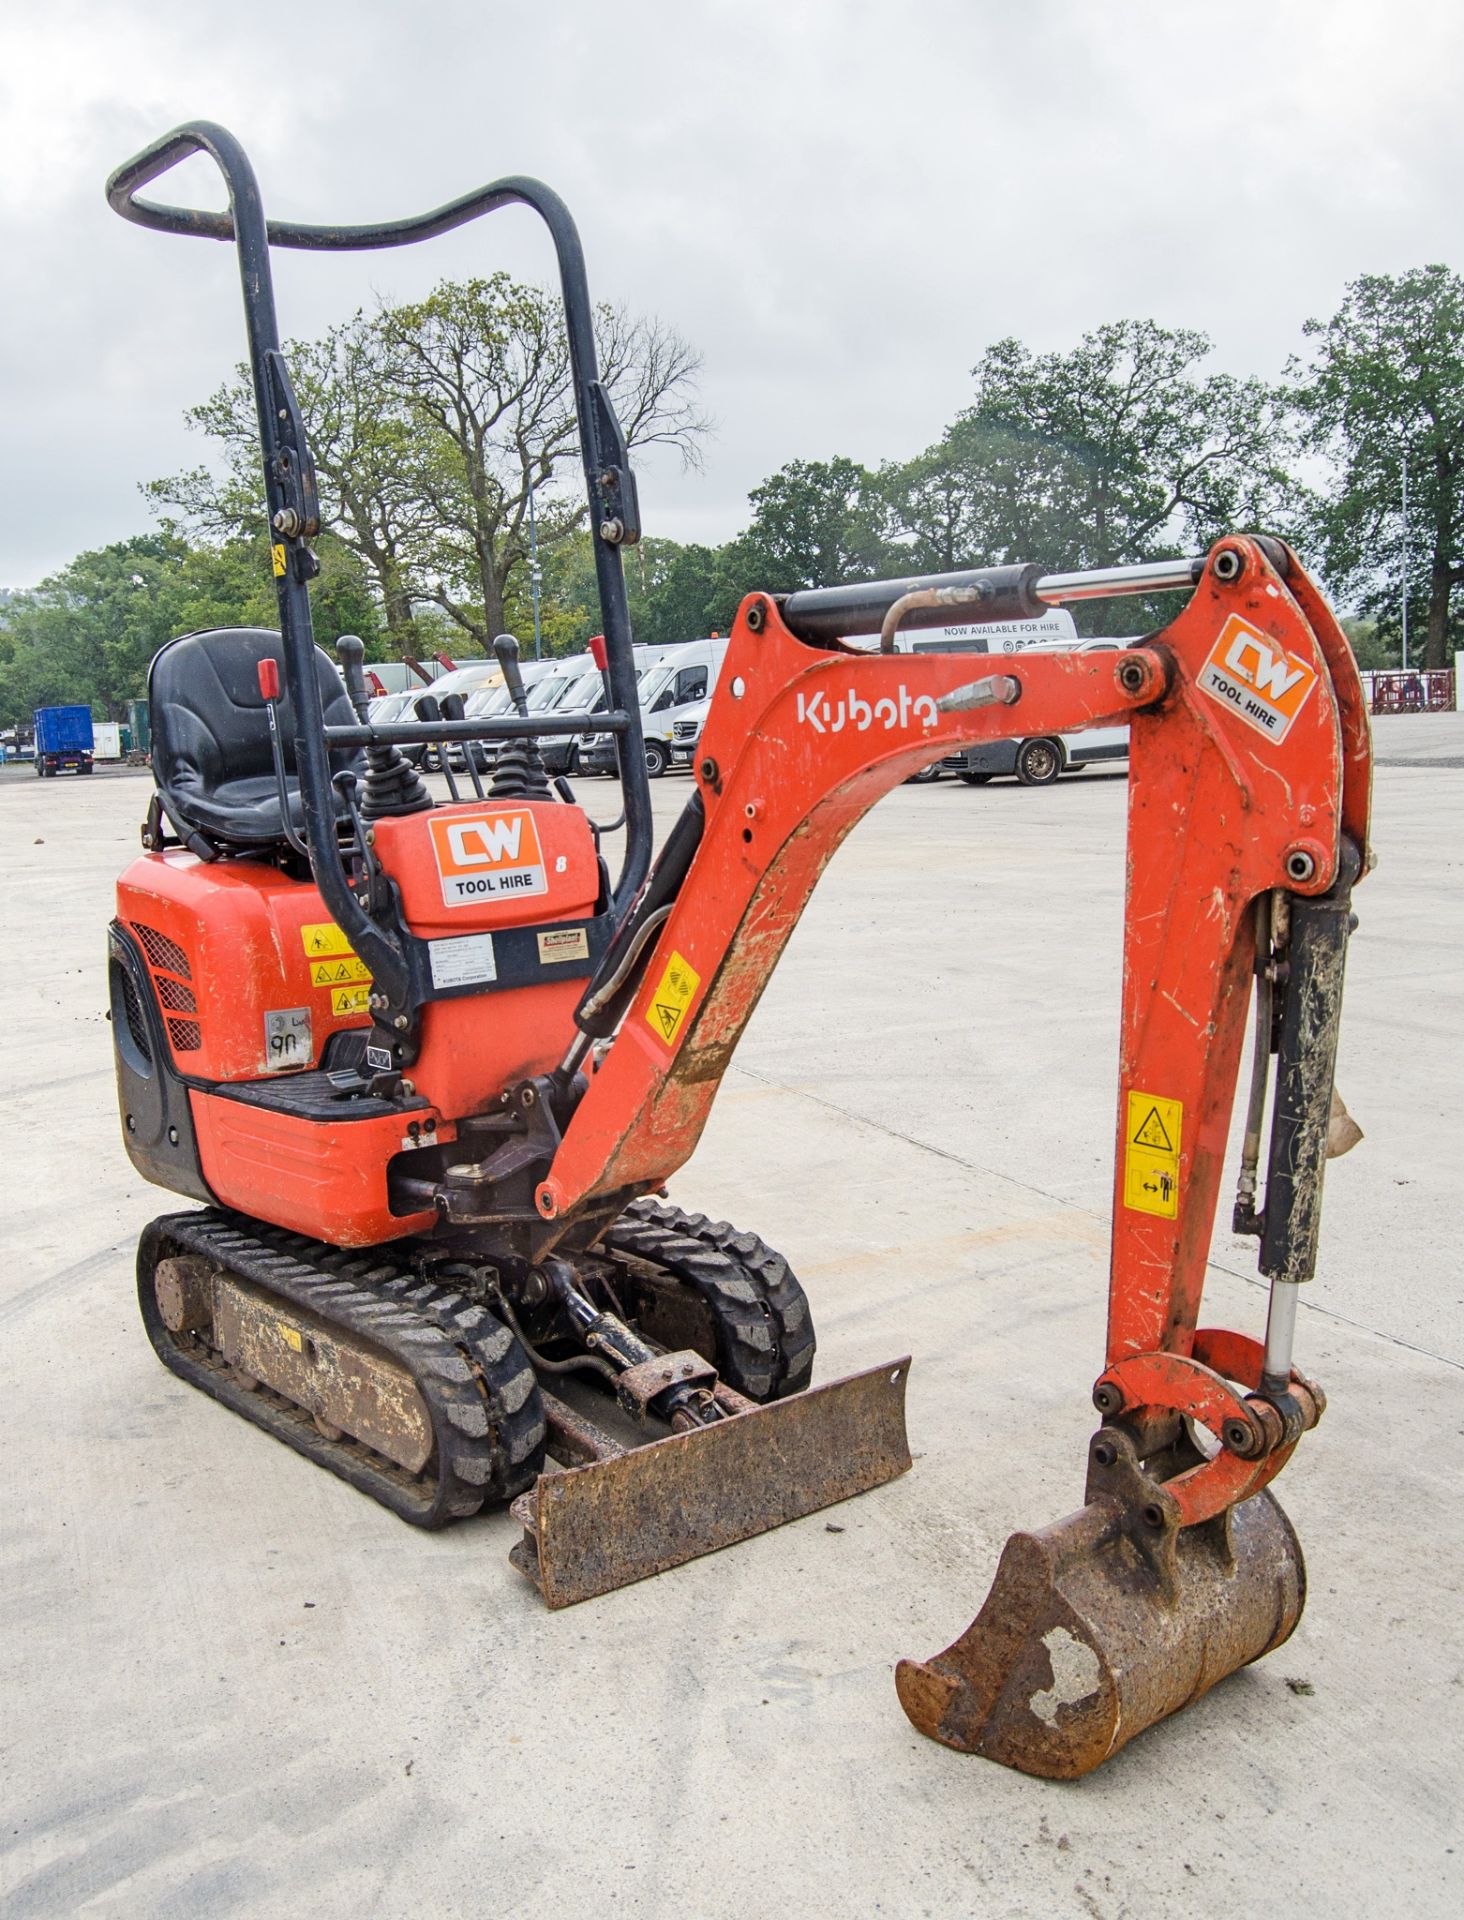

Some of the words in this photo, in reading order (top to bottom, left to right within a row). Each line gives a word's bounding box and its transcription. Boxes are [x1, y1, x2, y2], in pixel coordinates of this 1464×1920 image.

[944, 627, 968, 636] NOW
[971, 624, 1018, 635] AVAILABLE
[1020, 623, 1038, 632] FOR
[1040, 622, 1060, 631] HIRE
[1225, 631, 1305, 701] CW
[797, 684, 938, 733] Kubota
[1212, 674, 1242, 706] TOOL
[1245, 700, 1277, 728] HIRE
[447, 817, 523, 866] CW
[555, 856, 567, 873] 8
[456, 878, 496, 895] TOOL
[500, 873, 533, 890] HIRE
